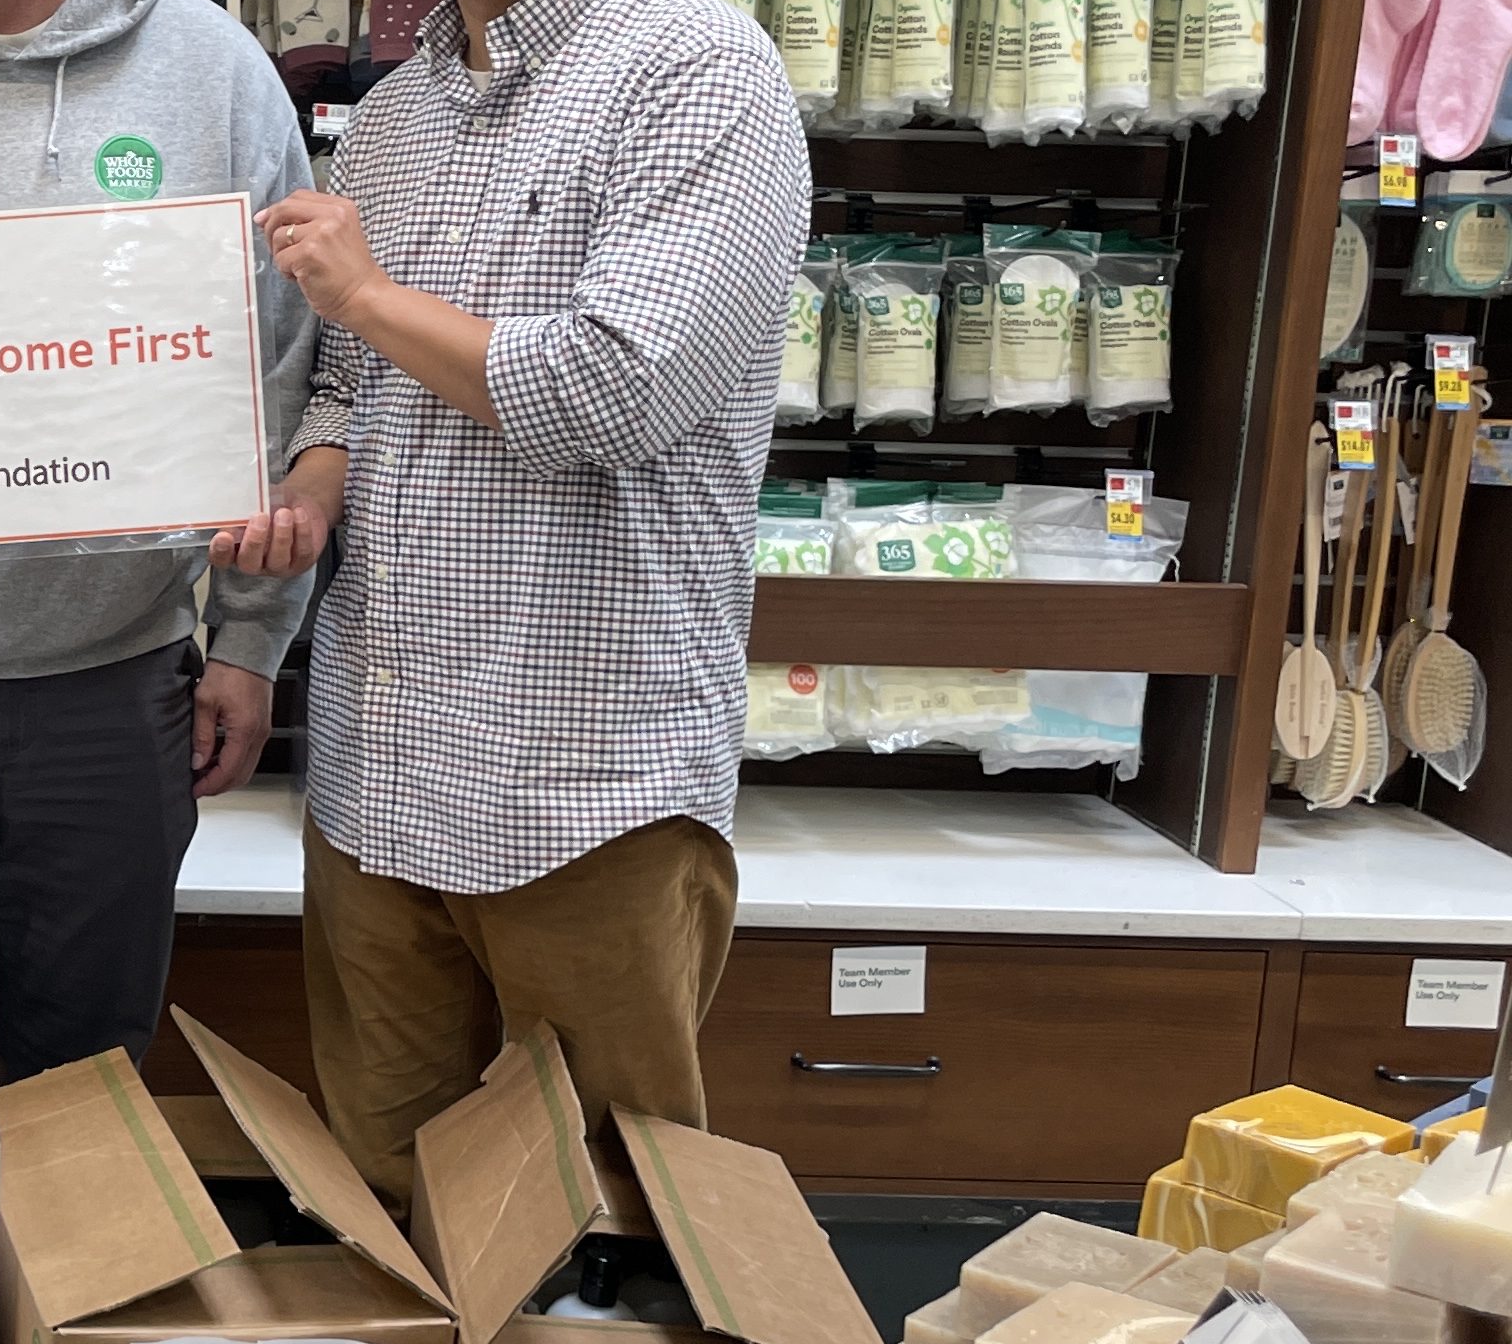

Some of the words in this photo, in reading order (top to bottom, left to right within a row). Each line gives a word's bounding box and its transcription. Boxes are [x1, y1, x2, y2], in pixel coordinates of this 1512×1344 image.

[786, 15, 817, 25] Cotton
[103, 156, 155, 169] WHOLE
[106, 167, 154, 179] FOODS
[108, 179, 153, 188] MARKET
[1000, 317, 1031, 327] Cotton
[108, 325, 213, 366] First
[1110, 511, 1135, 525] $4.30
[882, 544, 911, 561] 365
[790, 673, 815, 686] 100
[839, 968, 866, 976] Team
[868, 967, 912, 976] Member
[838, 979, 857, 988] Use
[859, 978, 883, 989] Only
[1417, 979, 1444, 989] Team
[1446, 980, 1489, 990] Member
[1416, 991, 1434, 999] Use
[1436, 991, 1460, 1002] Only
